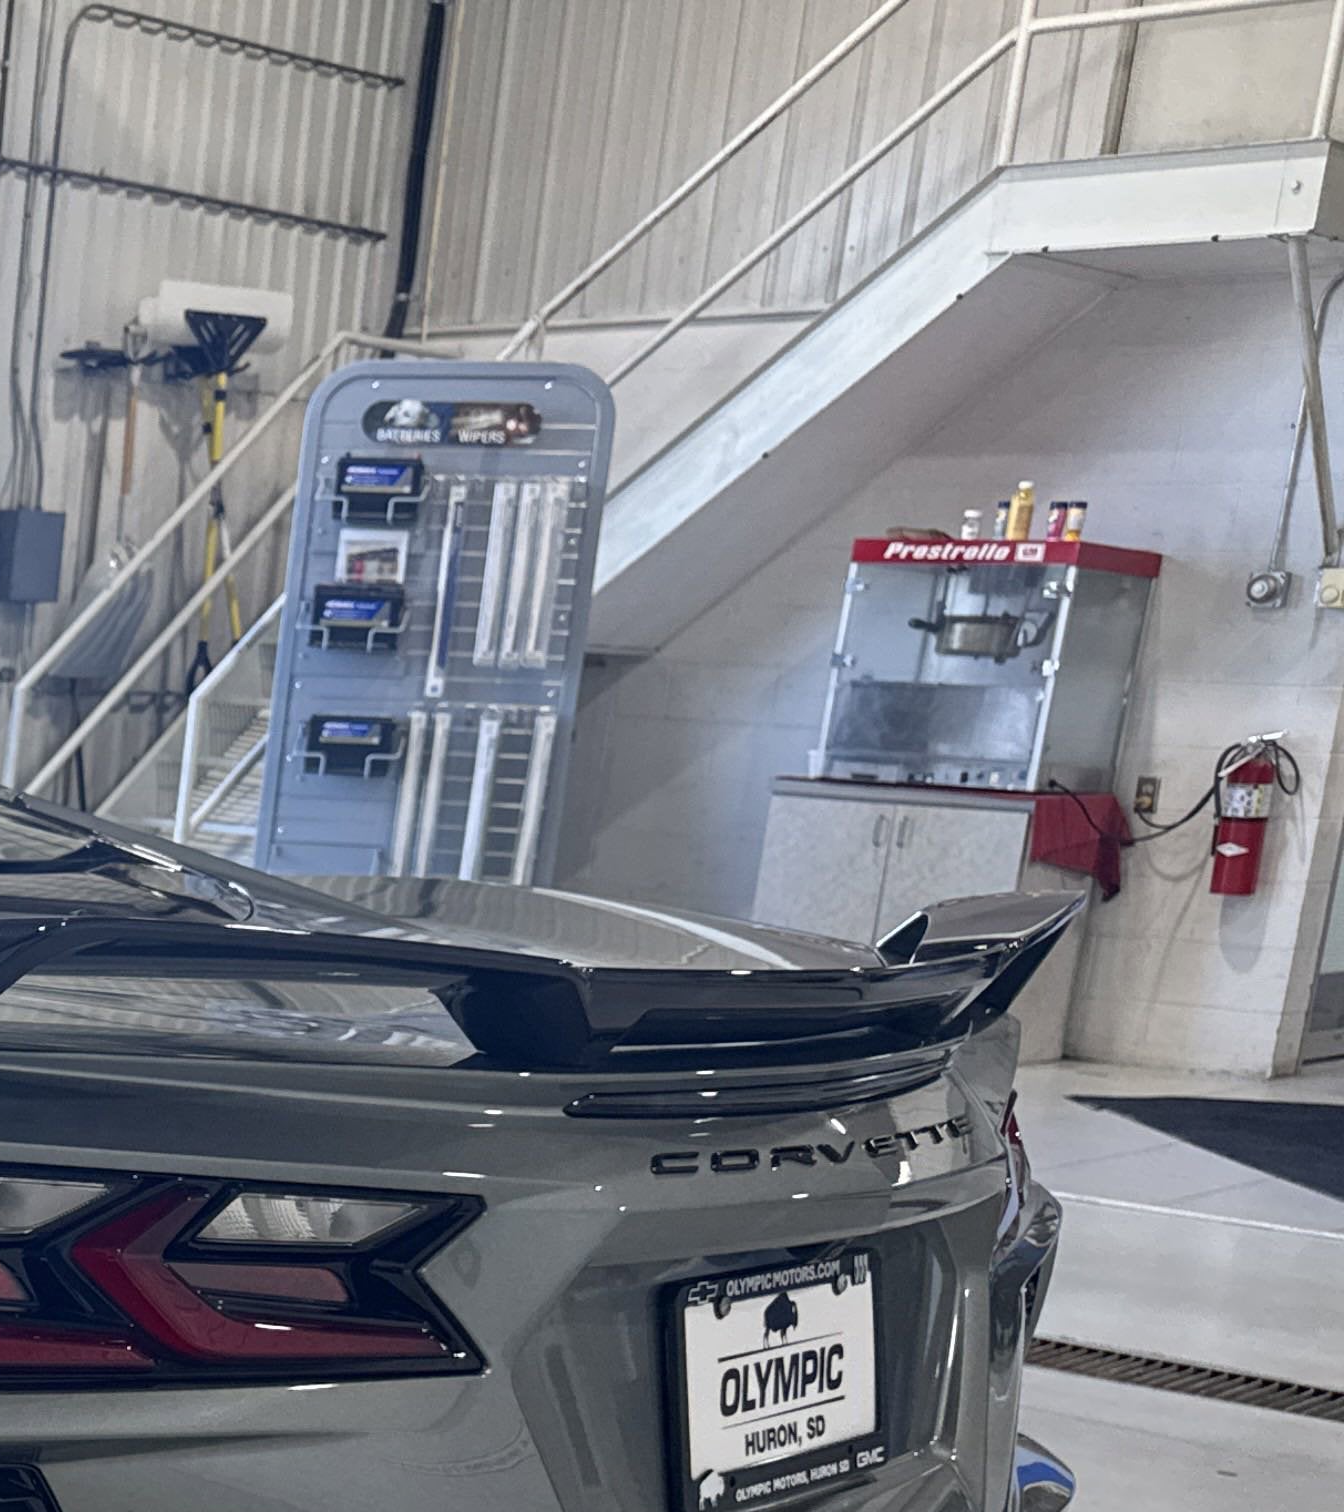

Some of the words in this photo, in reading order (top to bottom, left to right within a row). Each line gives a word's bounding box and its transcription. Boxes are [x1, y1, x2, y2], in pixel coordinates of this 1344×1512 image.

[375, 427, 442, 443] BATTERIES
[457, 429, 506, 444] WIPERS
[649, 1115, 974, 1176] CORVETTE
[719, 1343, 844, 1417] OLYMPIC
[744, 1421, 802, 1457] HURON,
[806, 1415, 826, 1440] SD
[856, 1446, 885, 1468] GMC
[735, 1480, 772, 1502] OLYMPIC
[810, 1462, 838, 1481] HURON
